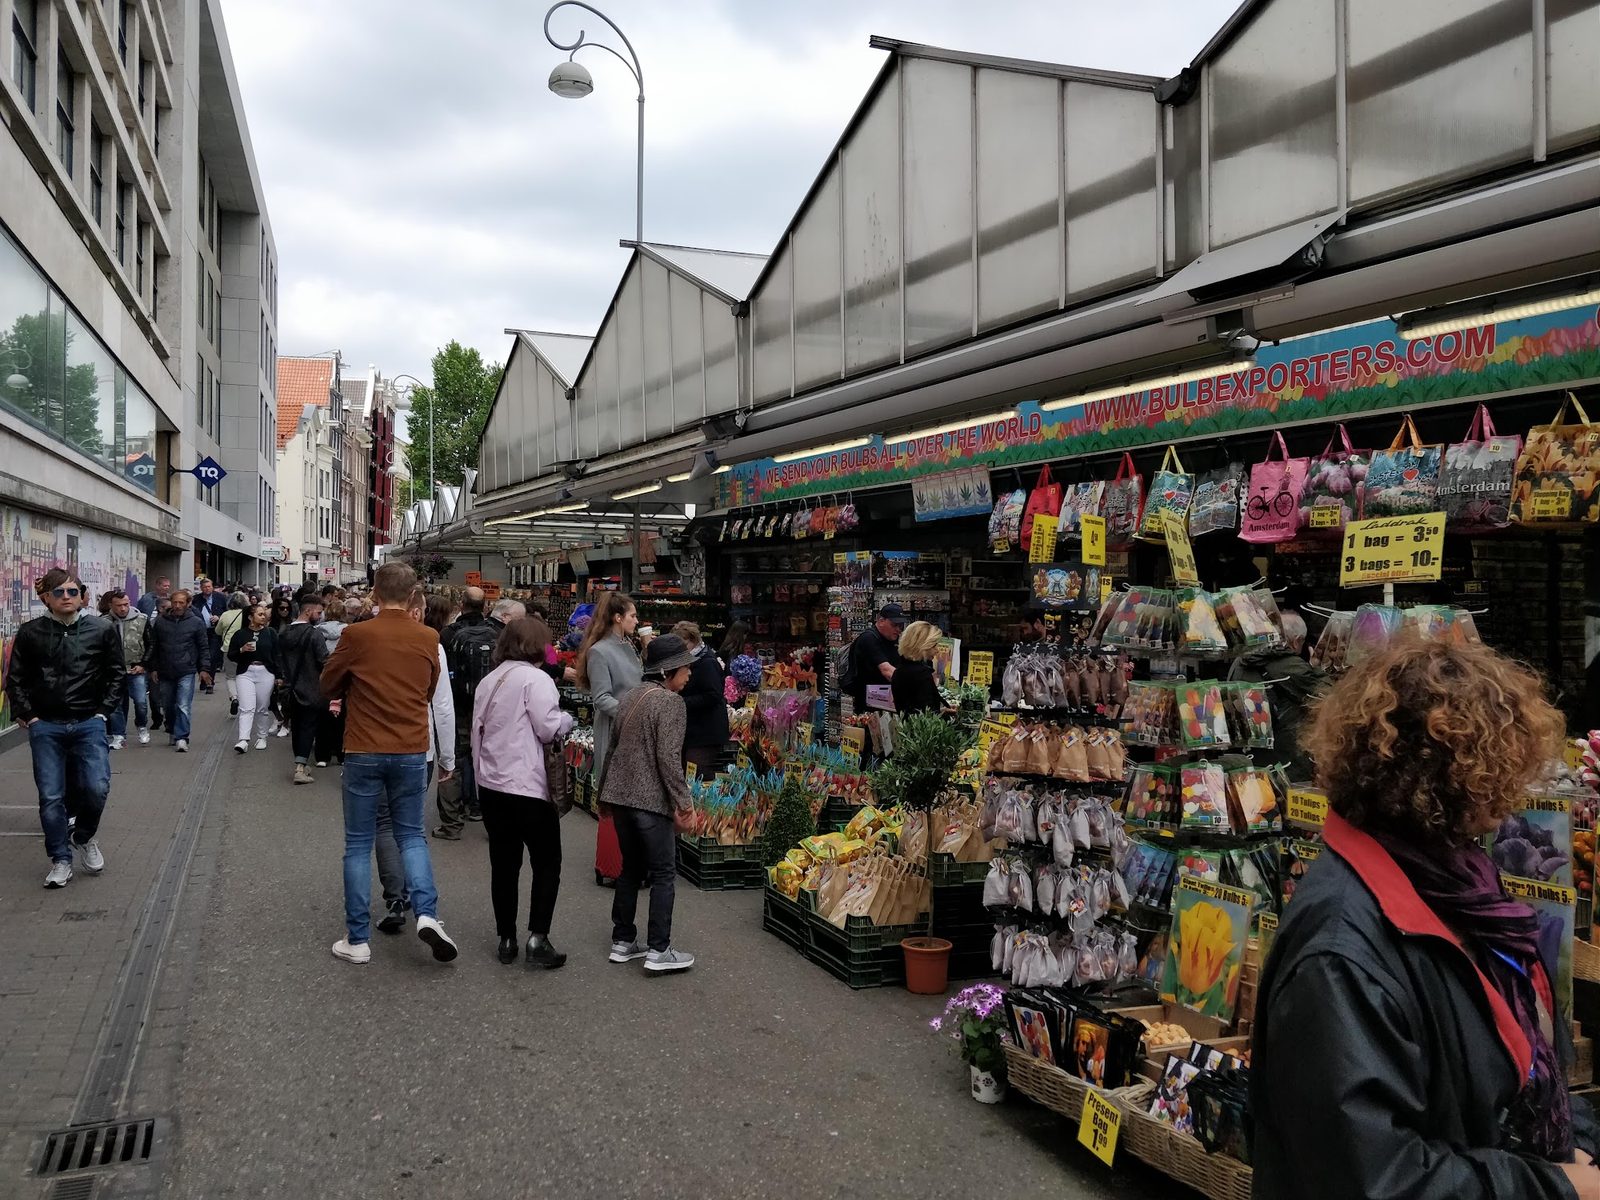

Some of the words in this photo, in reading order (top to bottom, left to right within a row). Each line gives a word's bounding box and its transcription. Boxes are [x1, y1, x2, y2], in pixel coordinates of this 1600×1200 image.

[1084, 323, 1496, 427] WWW.BULBEXPORTERS.COM
[765, 467, 780, 484] WE
[782, 460, 811, 482] SEND
[810, 454, 838, 475] YOUR
[840, 446, 877, 470] BULBS
[879, 441, 903, 465] ALL
[906, 435, 944, 459] OVER
[949, 426, 976, 451] THE
[981, 412, 1042, 445] WORLD
[199, 466, 219, 480] TQ
[1435, 481, 1511, 497] Amsterdam
[1248, 521, 1290, 533] Amsterdam
[1347, 533, 1355, 549] 1
[1364, 535, 1390, 548] bag
[1345, 556, 1356, 573] 3
[1360, 559, 1390, 571] bags
[1291, 795, 1299, 805] 10
[1300, 797, 1321, 810] Tulips
[1526, 798, 1535, 810] 20
[1536, 800, 1557, 812] Bulbs
[1214, 816, 1222, 824] 10
[1290, 808, 1299, 818] 20
[1300, 809, 1320, 823] Tulips
[1183, 878, 1197, 887] Giant
[1214, 886, 1223, 900] 20
[1223, 889, 1241, 904] Bulbs
[1526, 884, 1536, 897] 20
[1538, 885, 1560, 903] Bulbs
[1088, 1092, 1119, 1126] Present
[1092, 1112, 1109, 1136] Bag
